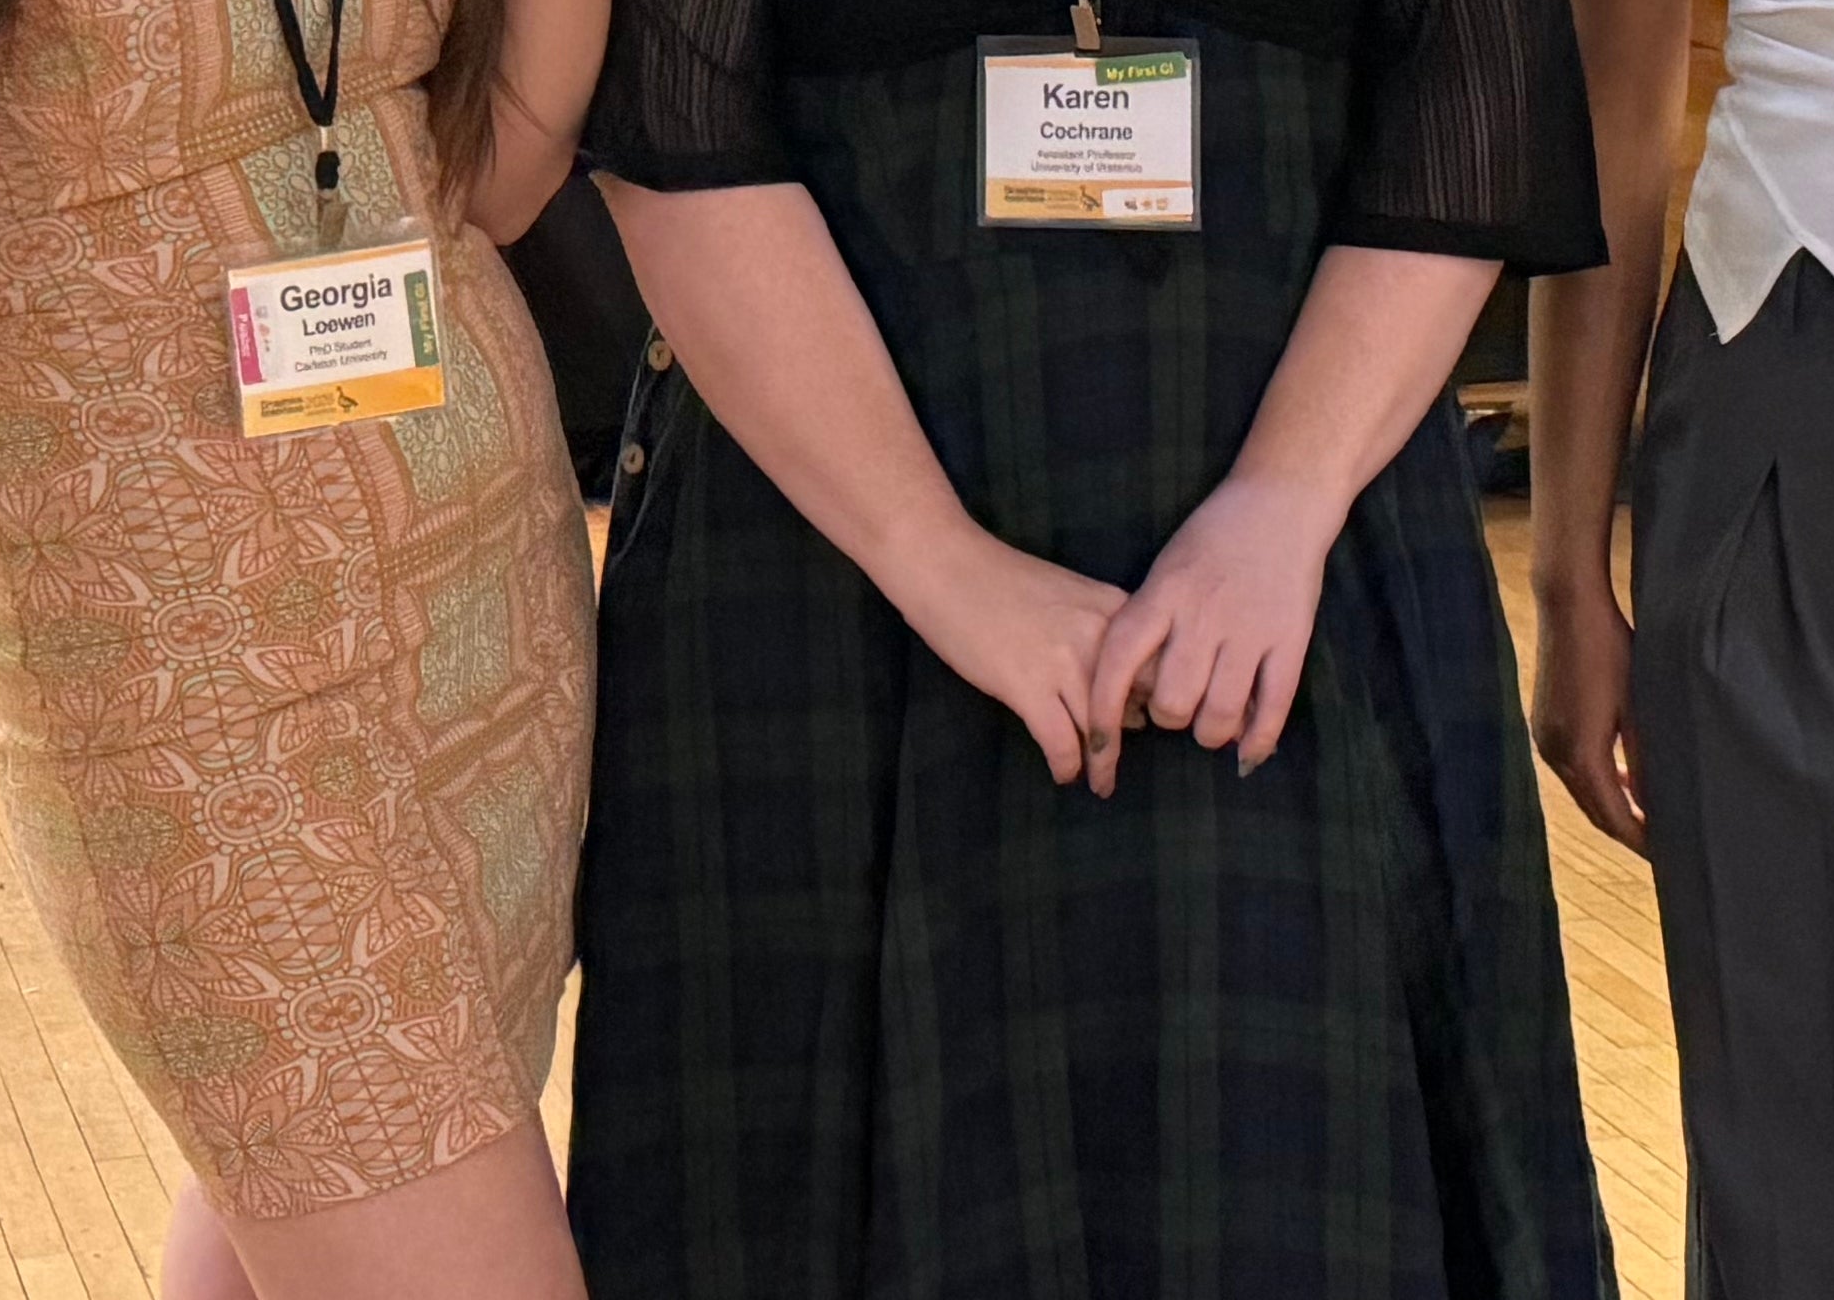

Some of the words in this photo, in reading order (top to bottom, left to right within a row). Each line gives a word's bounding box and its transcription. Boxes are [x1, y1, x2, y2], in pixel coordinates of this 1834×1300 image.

[1107, 67, 1124, 81] My
[1128, 65, 1156, 77] First
[1044, 83, 1129, 109] Karen
[1040, 122, 1133, 140] Cochrane
[1085, 162, 1094, 172] of
[280, 273, 392, 311] Georgia
[302, 312, 376, 336] Loewen
[335, 339, 371, 352] Student
